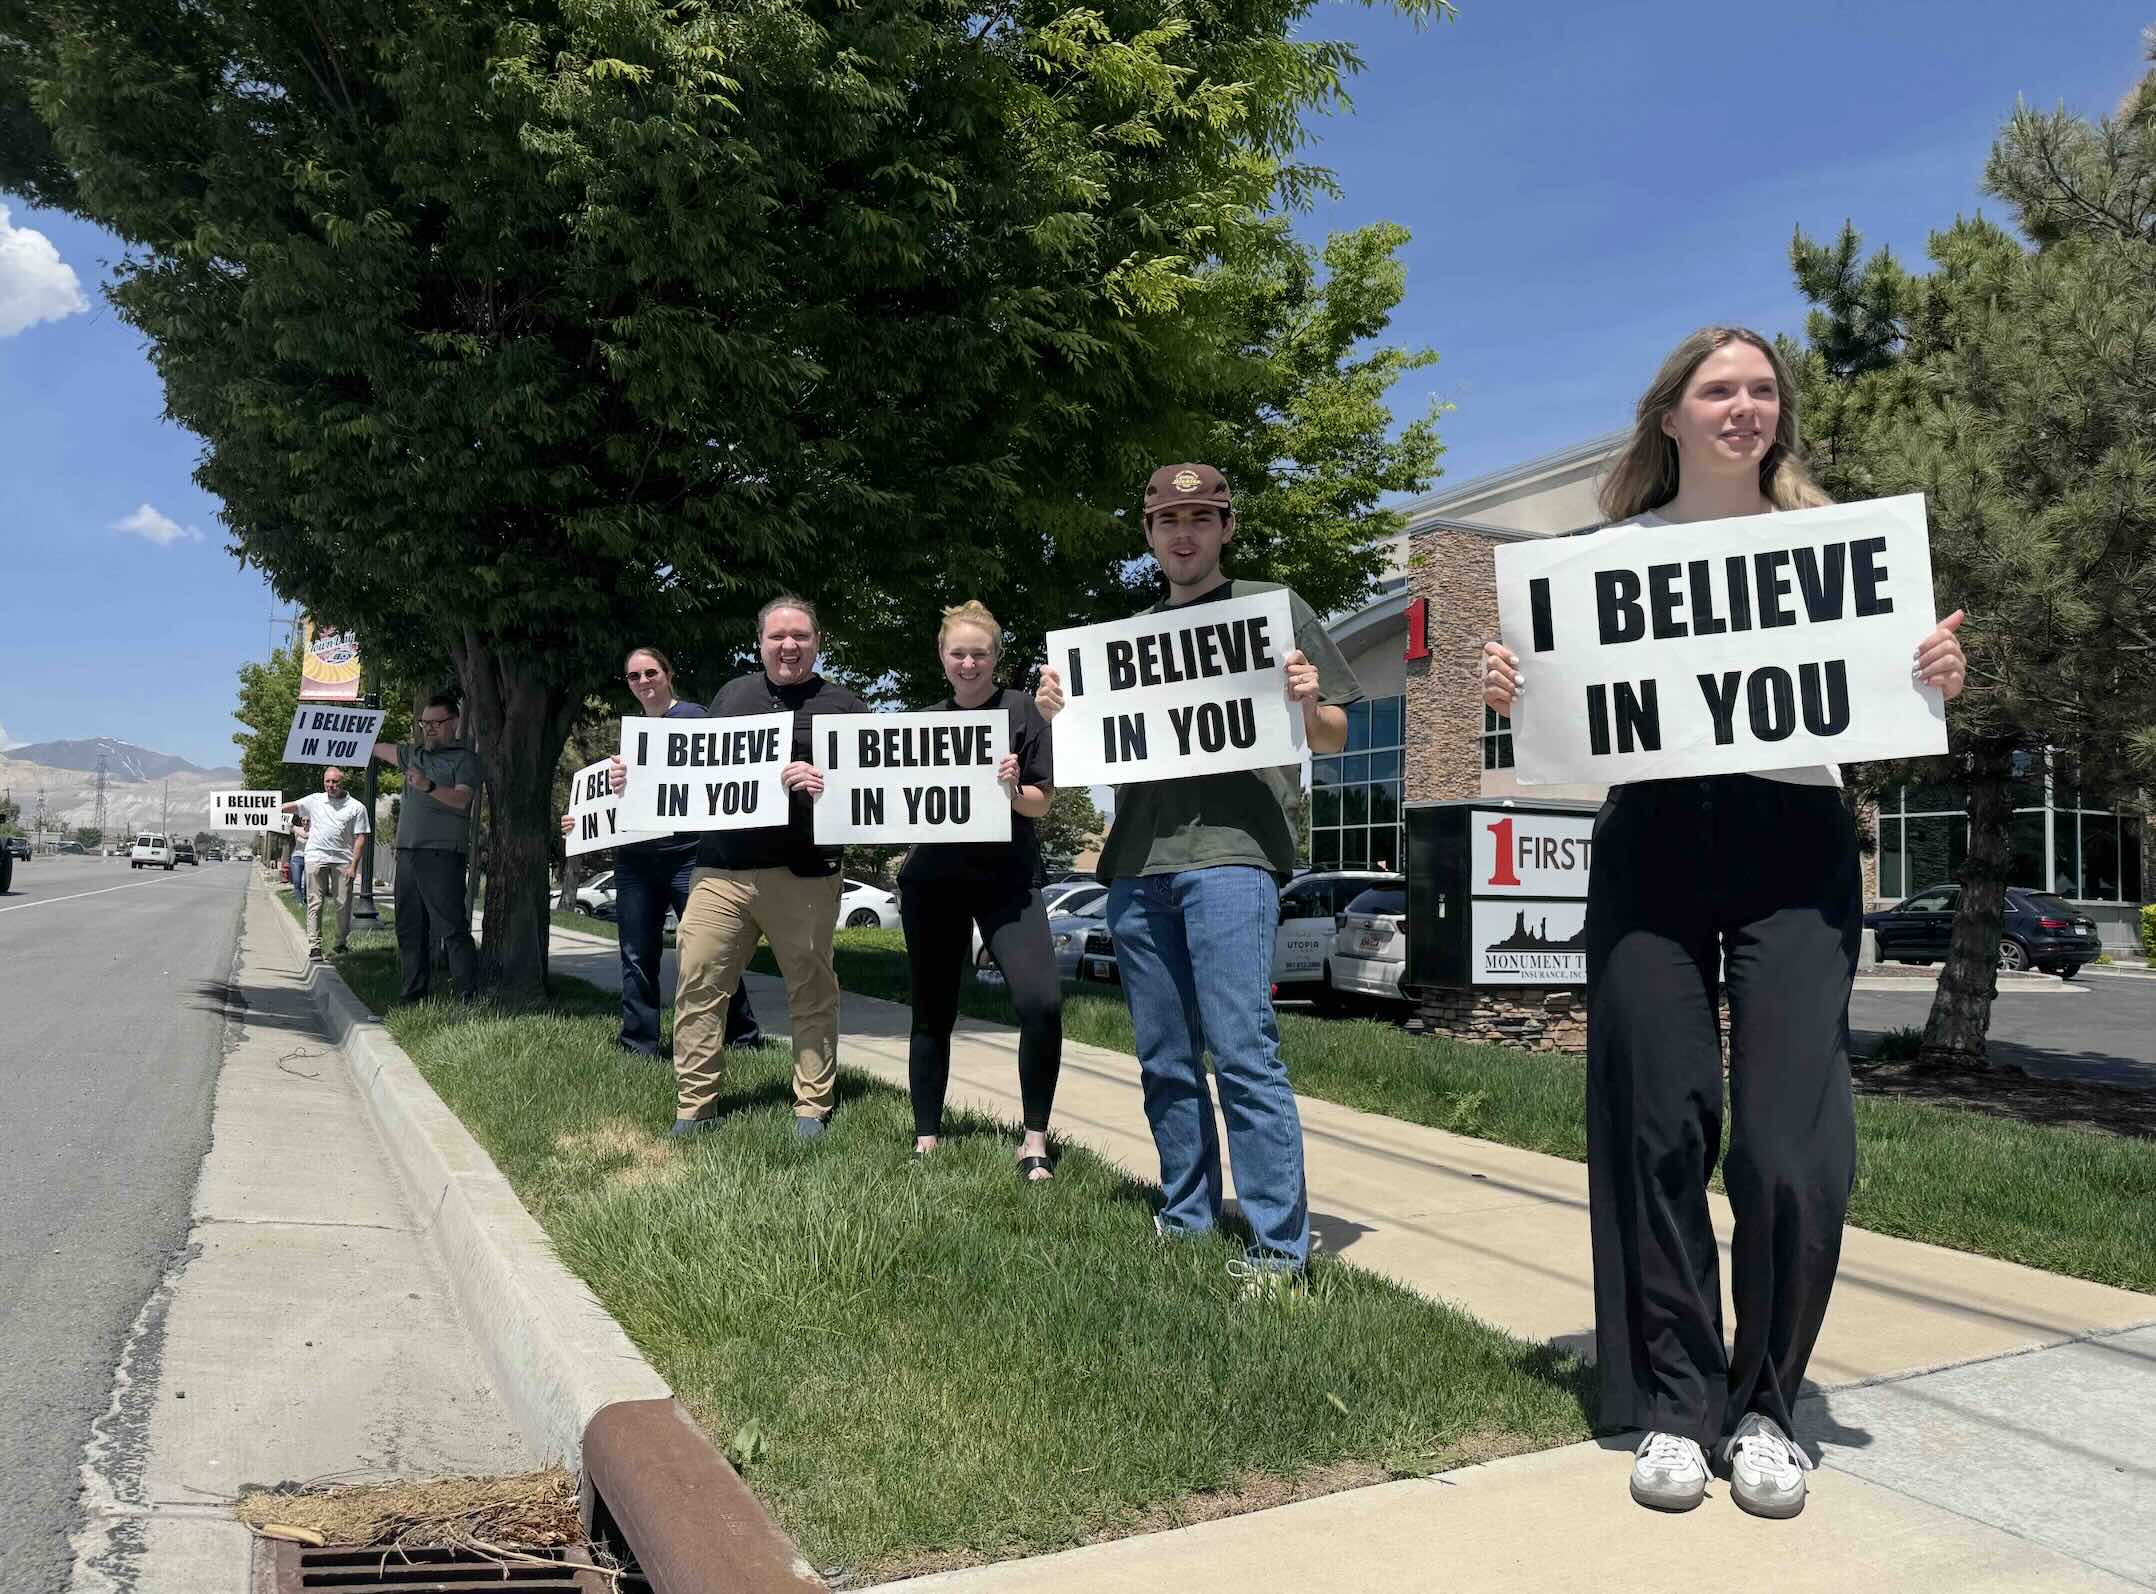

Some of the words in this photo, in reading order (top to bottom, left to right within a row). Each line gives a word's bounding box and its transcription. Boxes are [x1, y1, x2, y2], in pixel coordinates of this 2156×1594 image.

[1530, 578, 1554, 653] I
[1595, 536, 1893, 645] BELIEVE
[1403, 595, 1429, 663] 1
[1068, 648, 1084, 696] I
[1106, 616, 1275, 691] BELIEVE
[298, 712, 307, 729] I
[312, 712, 376, 733] BELIEVE
[1586, 679, 1661, 755] IN
[1696, 660, 1850, 745] YOU
[301, 738, 318, 755] IN
[327, 740, 358, 758] YOU
[637, 732, 648, 766] I
[667, 728, 779, 766] BELIEVE
[828, 731, 837, 769] I
[859, 725, 993, 768] BELIEVE
[1103, 713, 1147, 763] IN
[1168, 698, 1256, 755] YOU
[217, 796, 220, 807] I
[228, 796, 276, 808] BELIEVE
[574, 779, 581, 805] I
[657, 784, 688, 816] IN
[706, 780, 758, 815] YOU
[851, 788, 884, 825] IN
[903, 786, 970, 824] YOU
[226, 813, 237, 824] IN
[244, 814, 268, 825] YOU
[583, 812, 598, 840] IN
[1487, 818, 1520, 885] 1
[1519, 837, 1591, 871] FIRST
[1288, 941, 1318, 949] UTOPIA
[1486, 955, 1570, 968] MONUMENT
